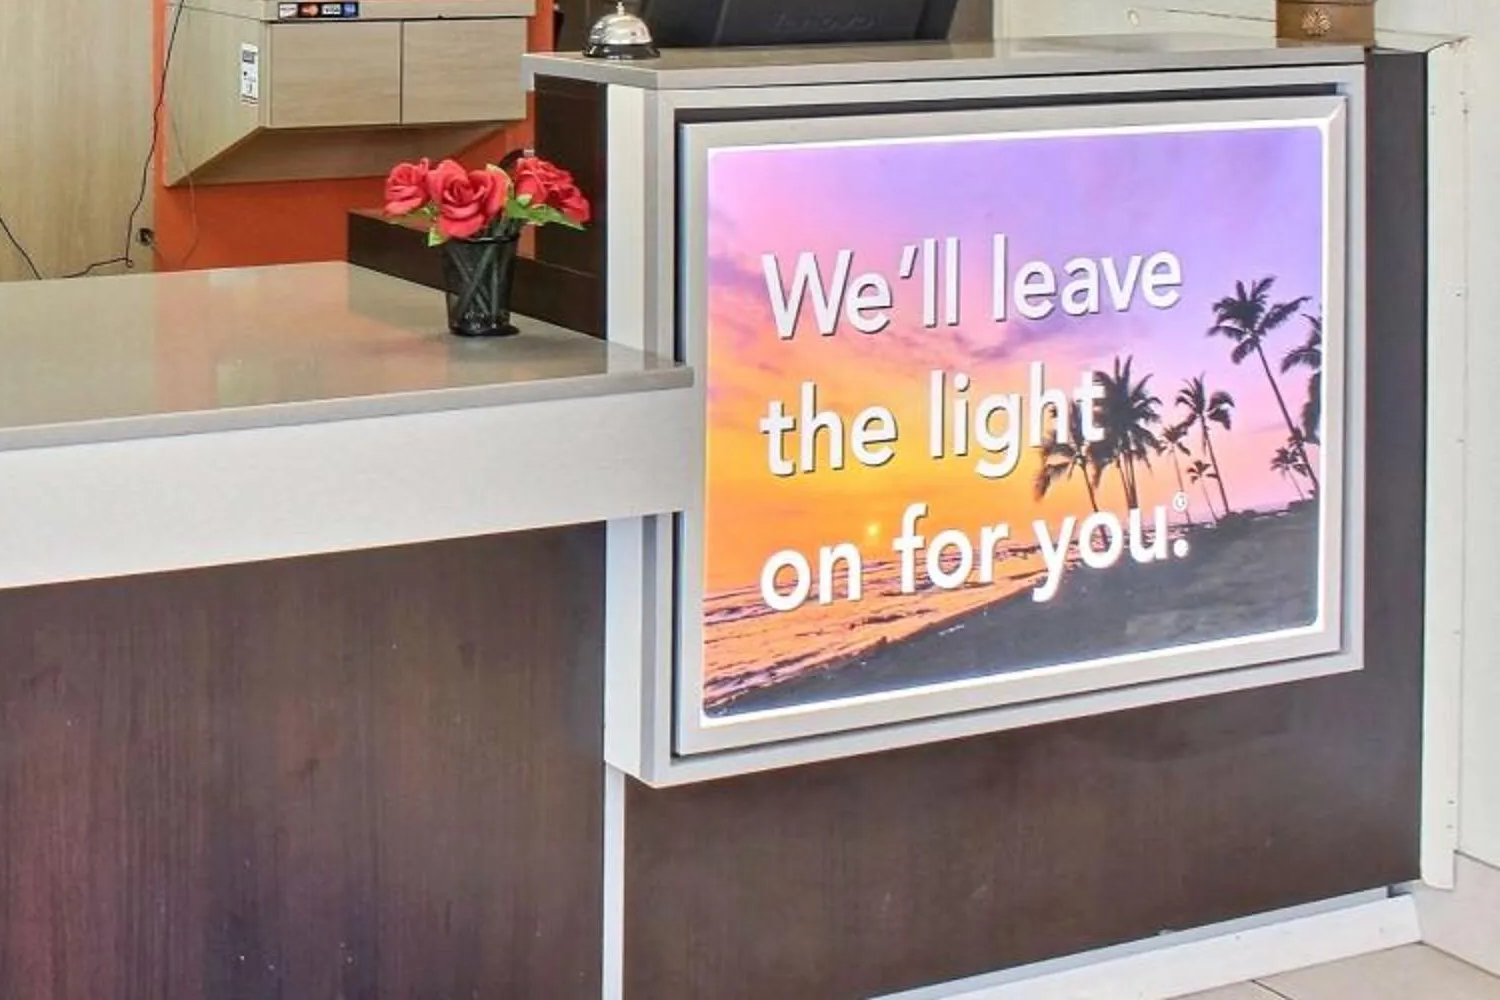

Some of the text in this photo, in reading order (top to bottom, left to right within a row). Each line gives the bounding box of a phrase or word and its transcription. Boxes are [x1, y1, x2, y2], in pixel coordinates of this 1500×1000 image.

[762, 234, 1182, 339] We'll leave
[759, 361, 1106, 478] the light
[760, 539, 863, 612] on
[892, 503, 1010, 594] for
